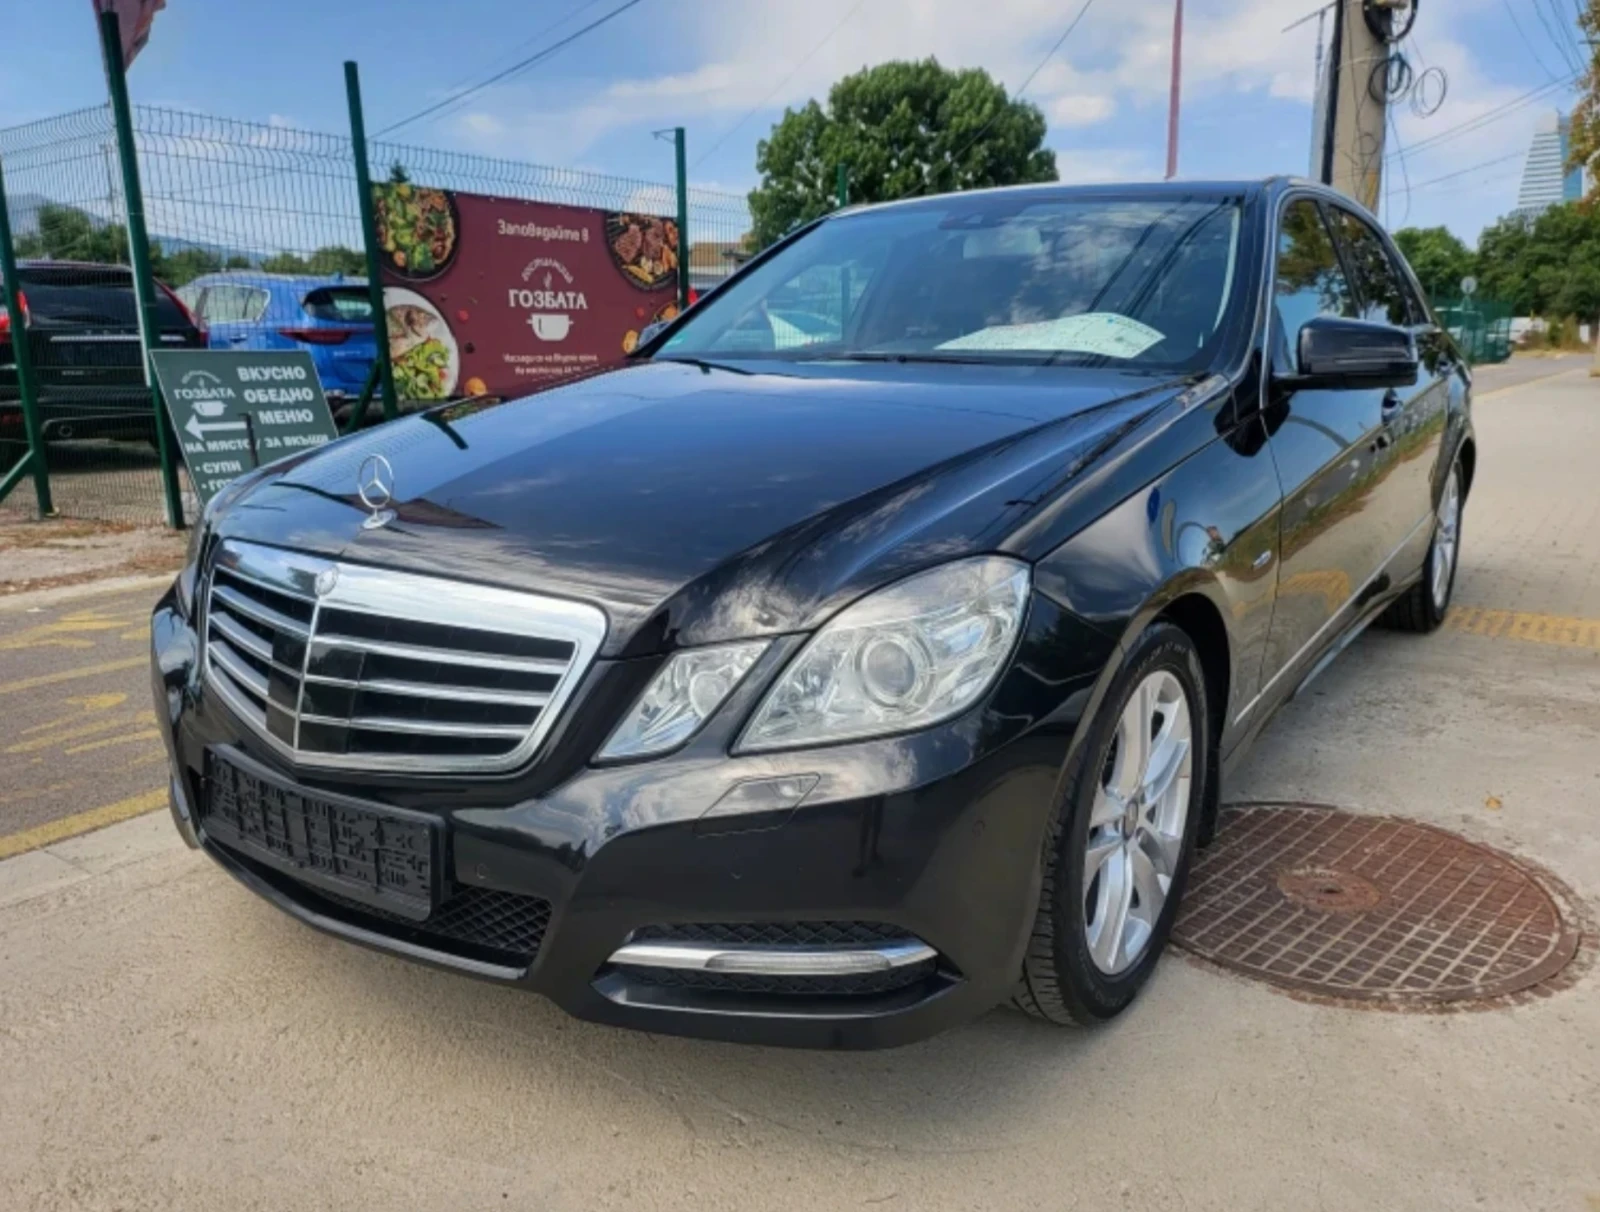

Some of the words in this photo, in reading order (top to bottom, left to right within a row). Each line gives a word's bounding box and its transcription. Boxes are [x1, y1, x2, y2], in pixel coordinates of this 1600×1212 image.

[497, 218, 580, 241] Заповядайте
[508, 289, 588, 310] ГОЗБАТА
[237, 366, 306, 382] ВКУСНО
[174, 387, 236, 400] ГОЗБАТА
[244, 388, 314, 406] ОБЕДНО
[258, 409, 314, 425] МЕНЮ
[185, 441, 204, 454] НА
[264, 436, 282, 449] ЗА
[203, 460, 242, 474] СУПИ
